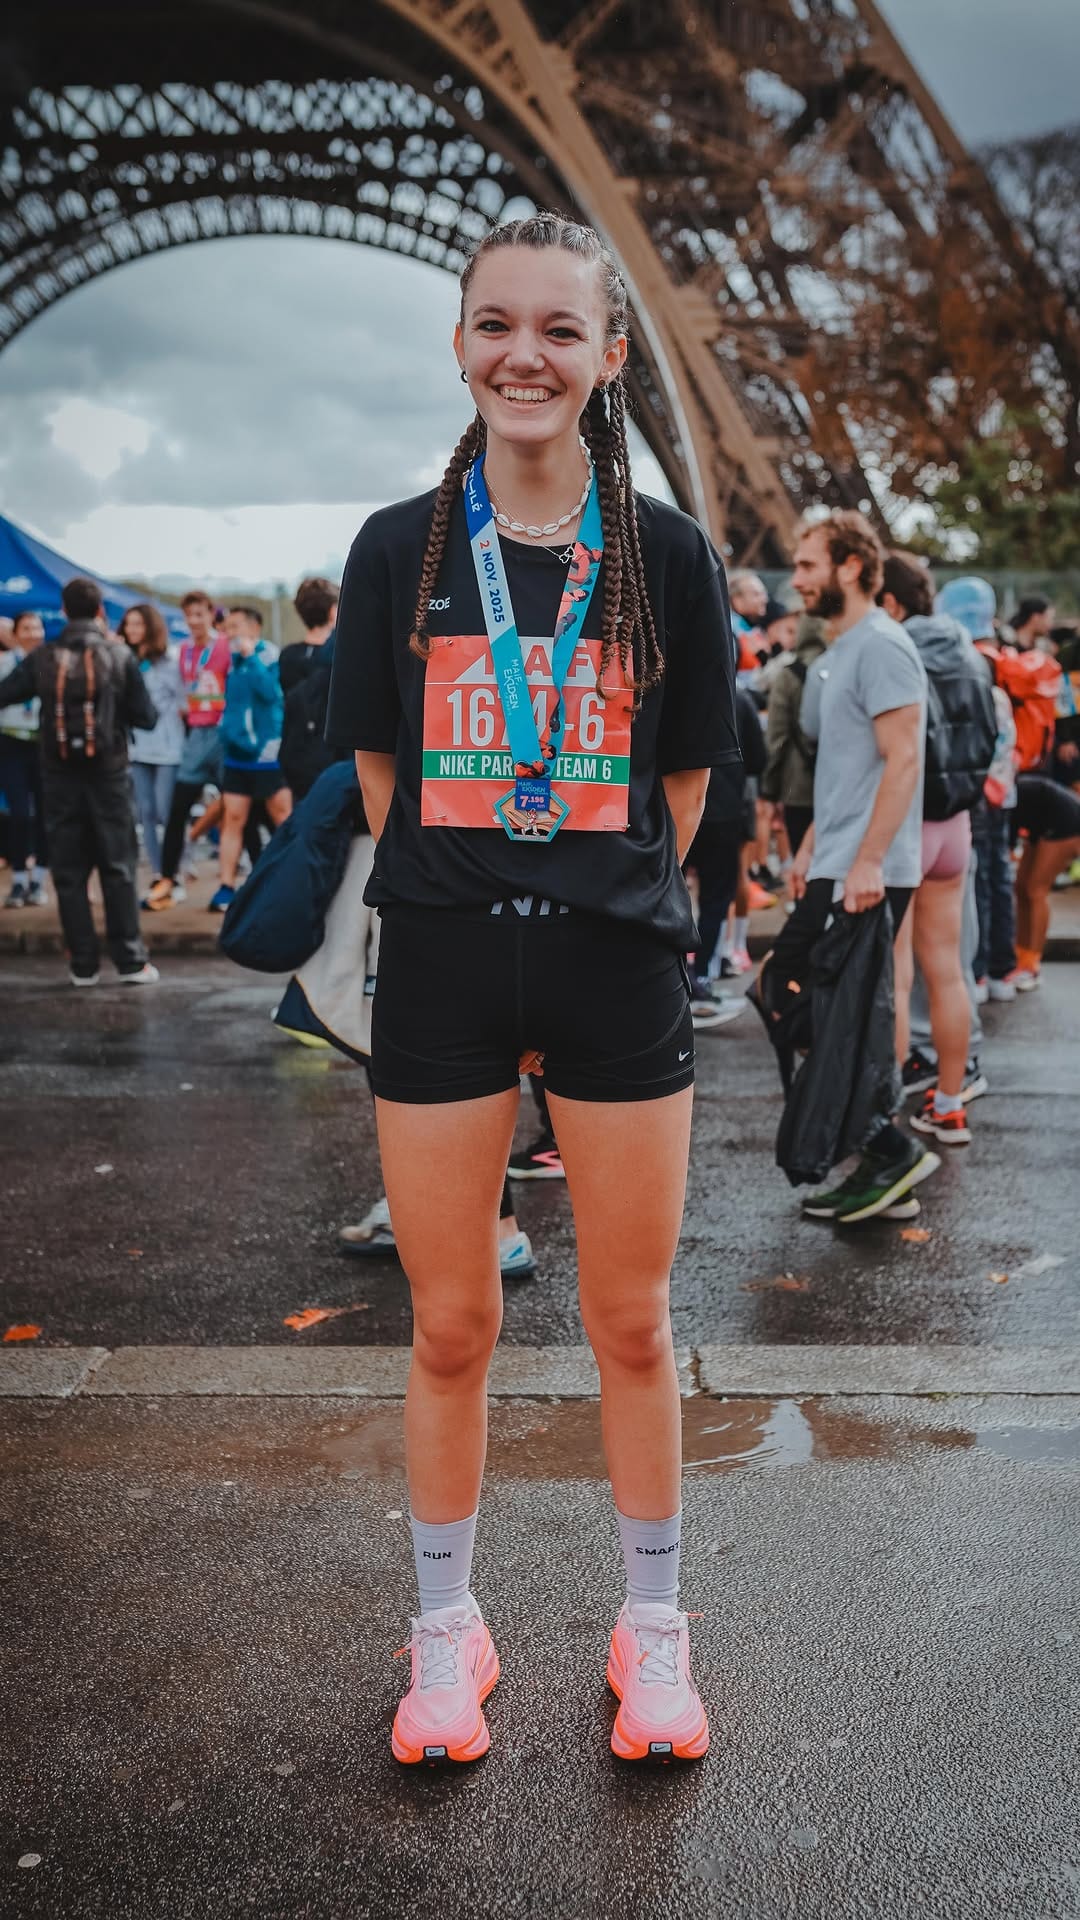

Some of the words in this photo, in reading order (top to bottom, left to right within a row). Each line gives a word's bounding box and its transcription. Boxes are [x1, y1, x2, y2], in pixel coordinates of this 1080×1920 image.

[480, 540, 490, 549] 2
[482, 552, 497, 587] NOV.
[489, 589, 505, 623] 2025
[447, 688, 606, 750] 164-6
[439, 755, 476, 776] NIKE
[481, 756, 516, 776] PAR
[556, 757, 596, 779] TEAM
[602, 760, 612, 780] 6
[423, 1551, 451, 1560] RUN
[635, 1541, 679, 1555] SMART
